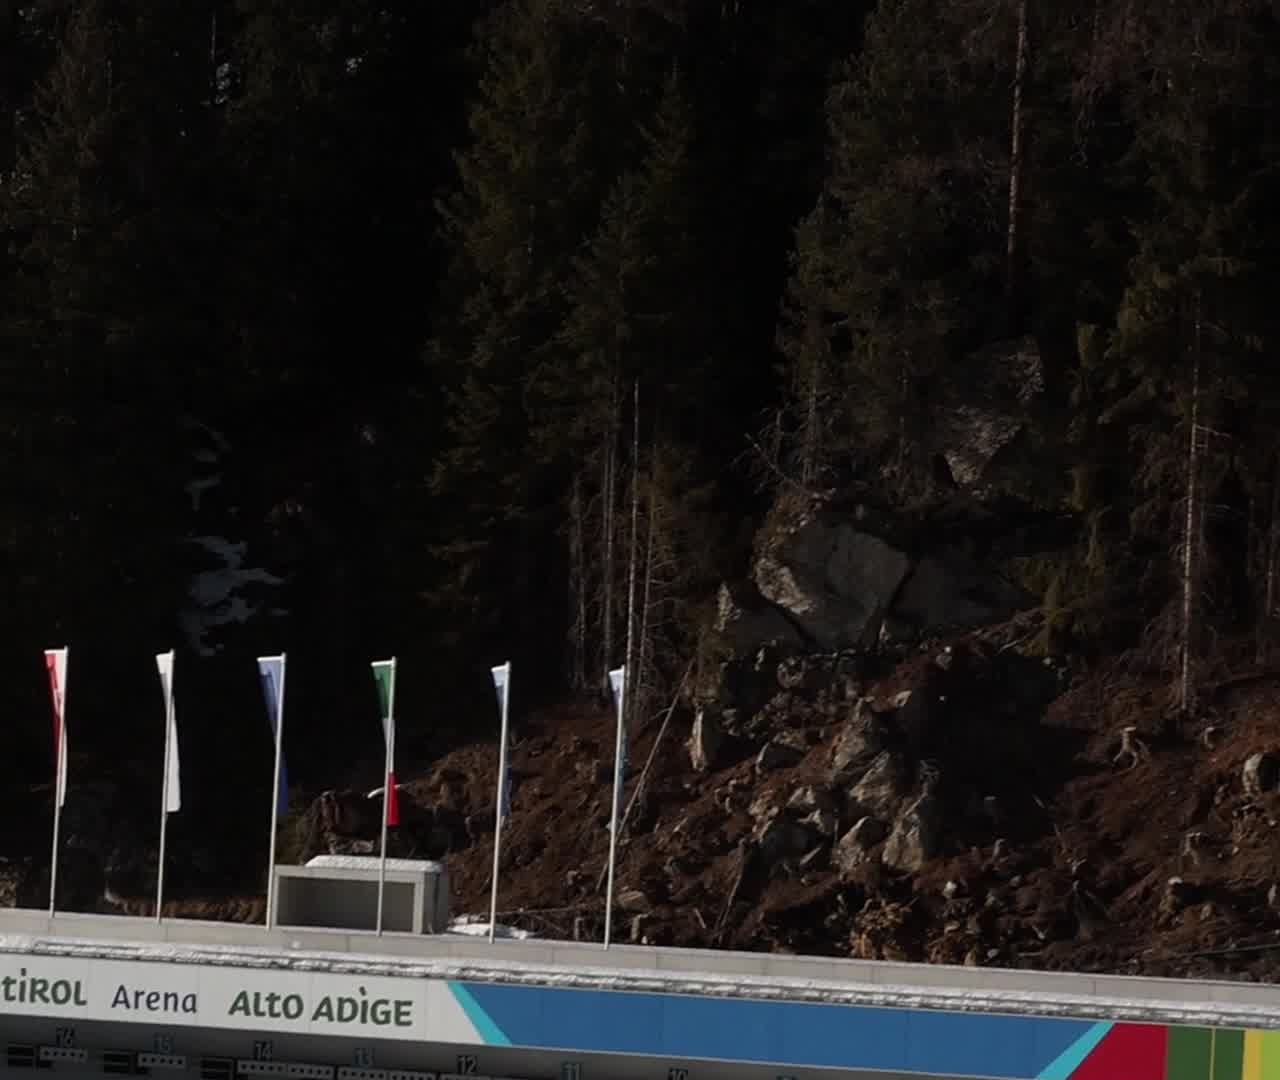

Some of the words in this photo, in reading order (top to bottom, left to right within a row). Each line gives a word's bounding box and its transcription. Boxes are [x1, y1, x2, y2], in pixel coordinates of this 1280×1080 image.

[111, 984, 197, 1013] Arena
[458, 1055, 476, 1074] 12
[565, 1063, 583, 1080] 11
